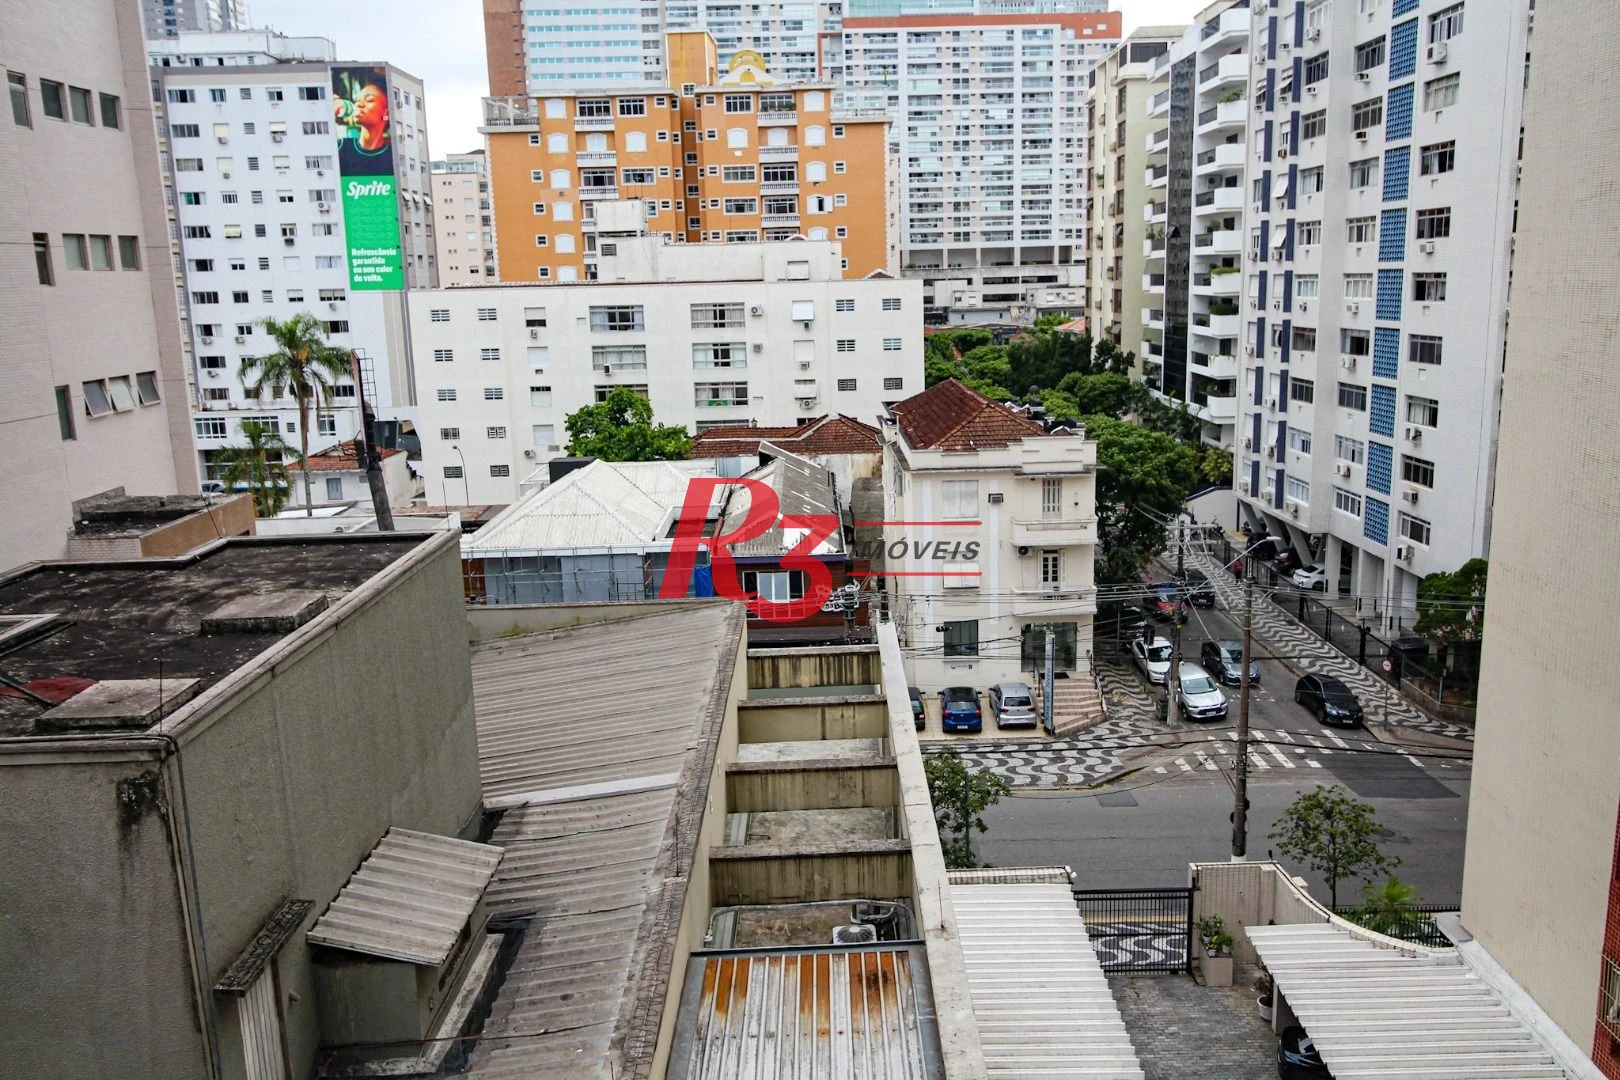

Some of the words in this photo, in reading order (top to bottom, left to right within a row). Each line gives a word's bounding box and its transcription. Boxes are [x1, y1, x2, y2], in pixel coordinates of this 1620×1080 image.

[346, 181, 391, 199] Sprite
[352, 257, 386, 267] garantida
[353, 266, 363, 274] ou
[376, 265, 394, 273] calor
[363, 274, 383, 282] volta.
